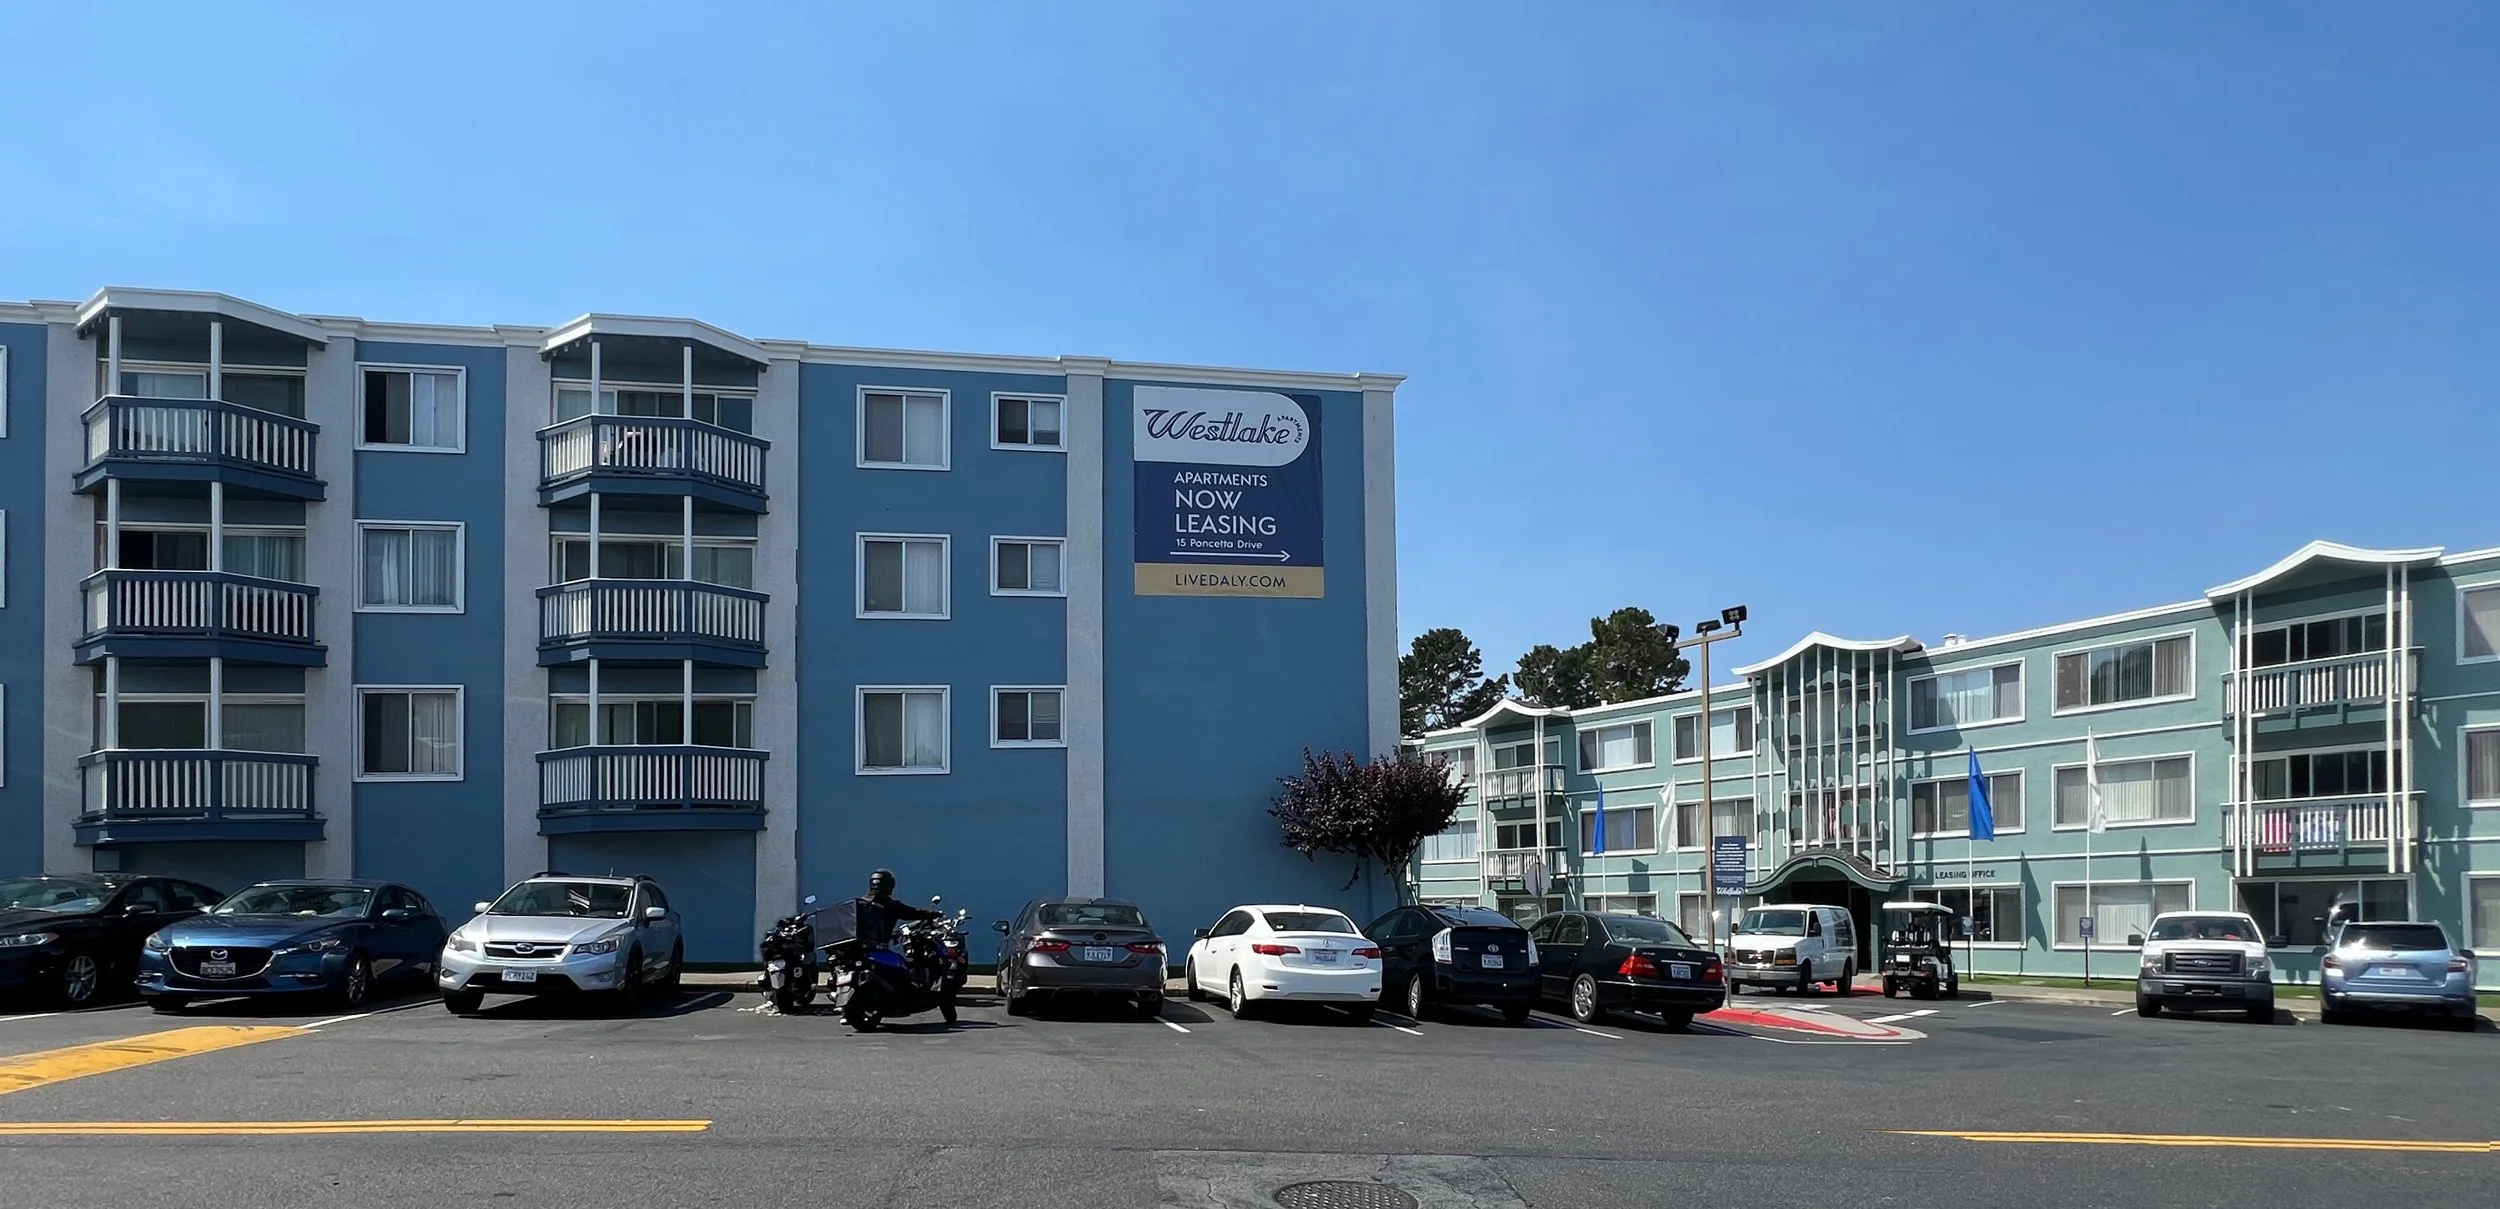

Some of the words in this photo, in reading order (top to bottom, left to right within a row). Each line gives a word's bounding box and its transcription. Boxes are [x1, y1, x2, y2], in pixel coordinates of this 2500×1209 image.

[1143, 409, 1290, 444] Westlake
[1277, 415, 1302, 443] APARTMENTS
[1174, 472, 1268, 487] APARTMENTS
[1175, 489, 1243, 510] NOW
[1175, 513, 1277, 536] LEASING
[1176, 538, 1187, 547] 15
[1190, 539, 1234, 549] Poncetta
[1237, 540, 1263, 549] Drive
[1175, 574, 1286, 588] LIVEDALY.COM
[1935, 871, 1967, 879] LEASING
